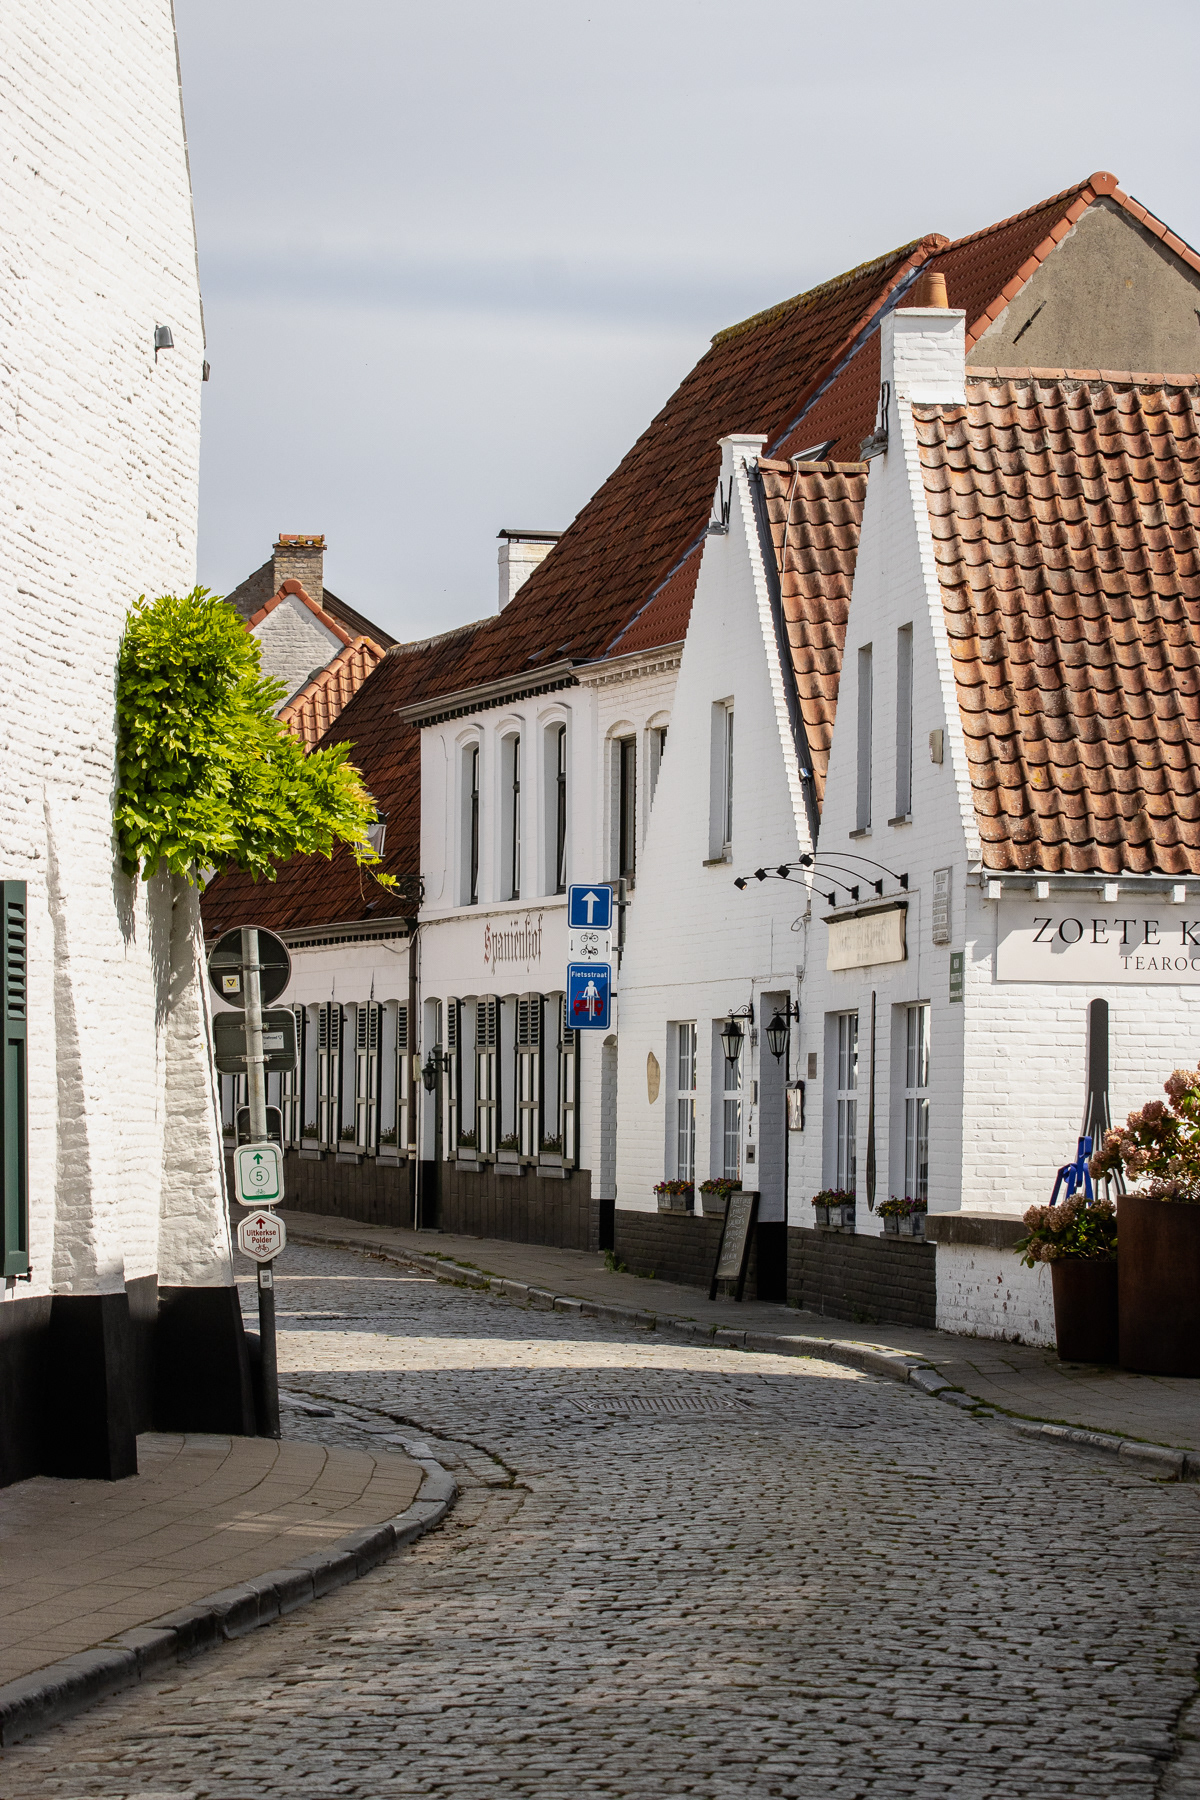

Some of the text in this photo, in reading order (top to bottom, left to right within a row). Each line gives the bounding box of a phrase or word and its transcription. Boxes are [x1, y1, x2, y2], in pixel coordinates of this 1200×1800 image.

[1032, 917, 1161, 945] ZOETE
[256, 1171, 263, 1182] 5
[251, 1236, 273, 1244] Polder
